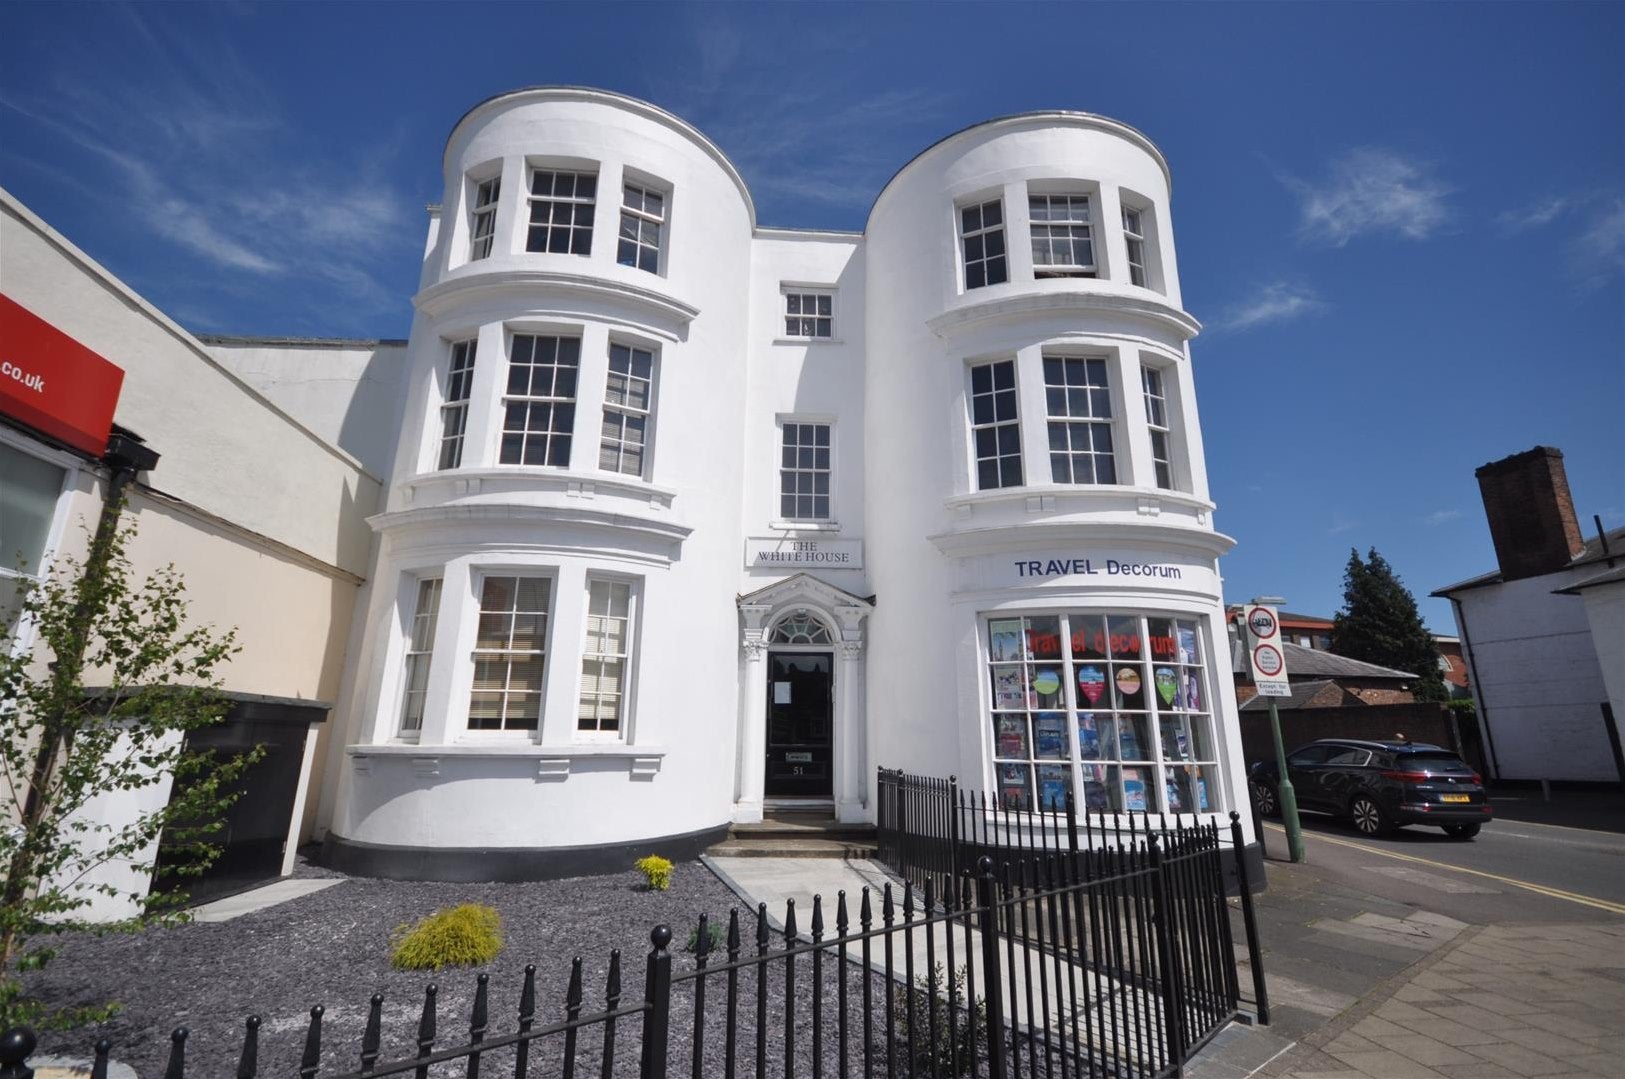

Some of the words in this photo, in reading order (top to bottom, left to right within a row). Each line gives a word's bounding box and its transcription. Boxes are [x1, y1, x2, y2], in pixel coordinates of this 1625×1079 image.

[791, 541, 818, 552] THE
[759, 551, 802, 562] WHITE
[806, 552, 849, 563] HOUSE
[1015, 559, 1098, 577] TRAVEL
[1106, 559, 1181, 579] Decorum
[793, 766, 804, 776] 51
